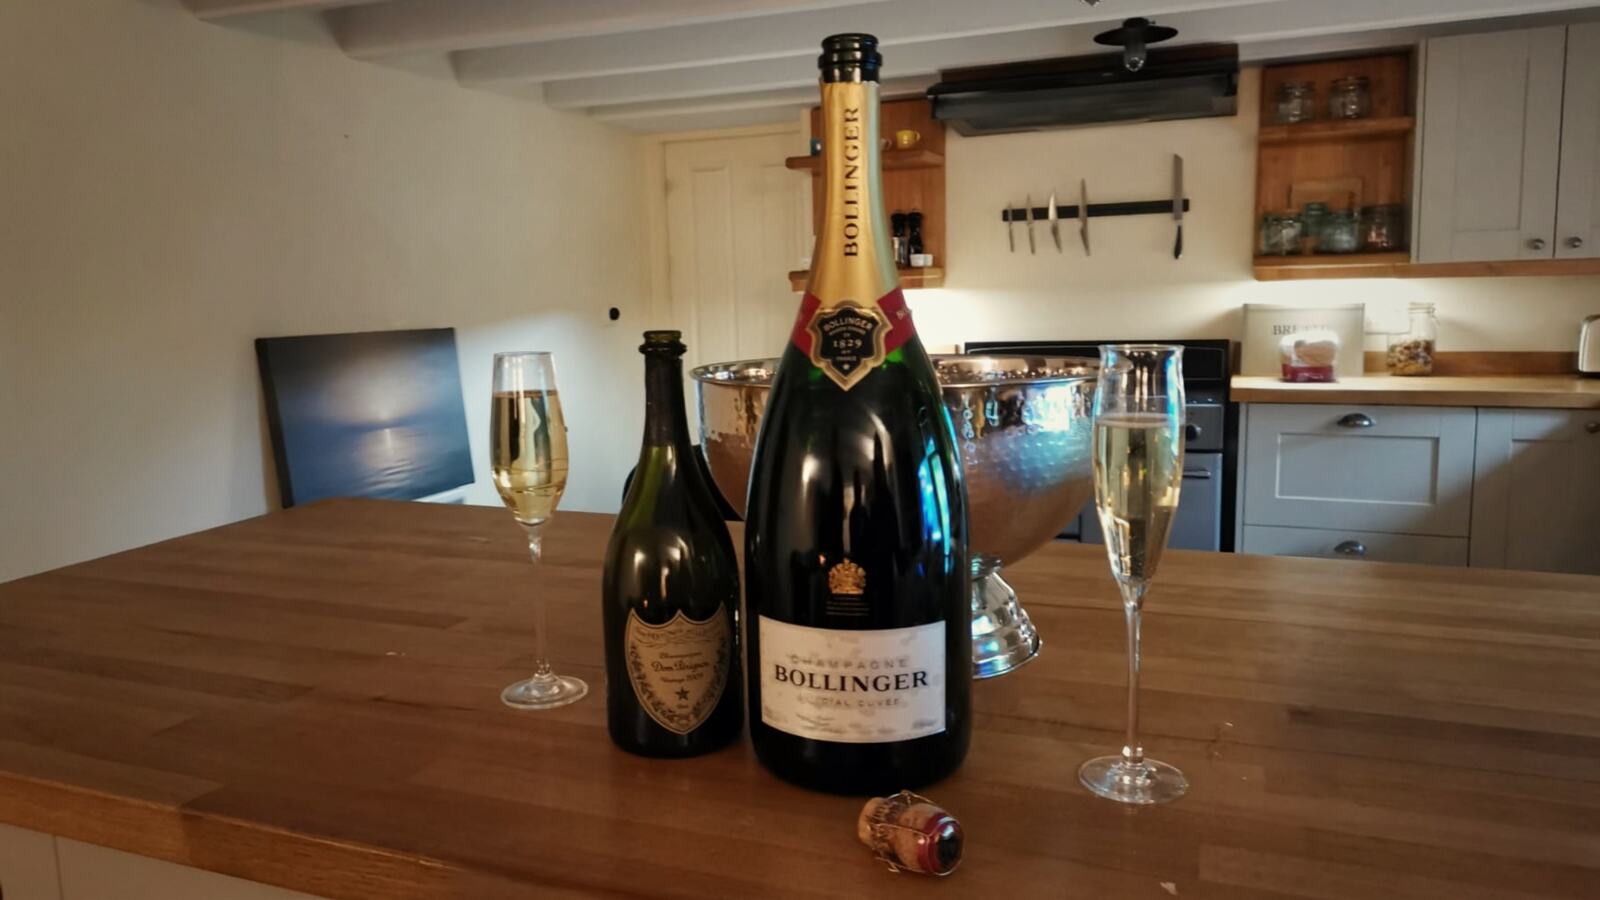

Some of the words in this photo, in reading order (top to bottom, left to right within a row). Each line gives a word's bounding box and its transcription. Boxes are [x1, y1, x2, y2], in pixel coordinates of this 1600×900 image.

[843, 107, 859, 257] BOLLINGER
[822, 316, 874, 332] BOLLINGER
[833, 338, 863, 349] 1829
[789, 654, 909, 670] CHAMPAGNE
[774, 664, 929, 692] BOLLINGER
